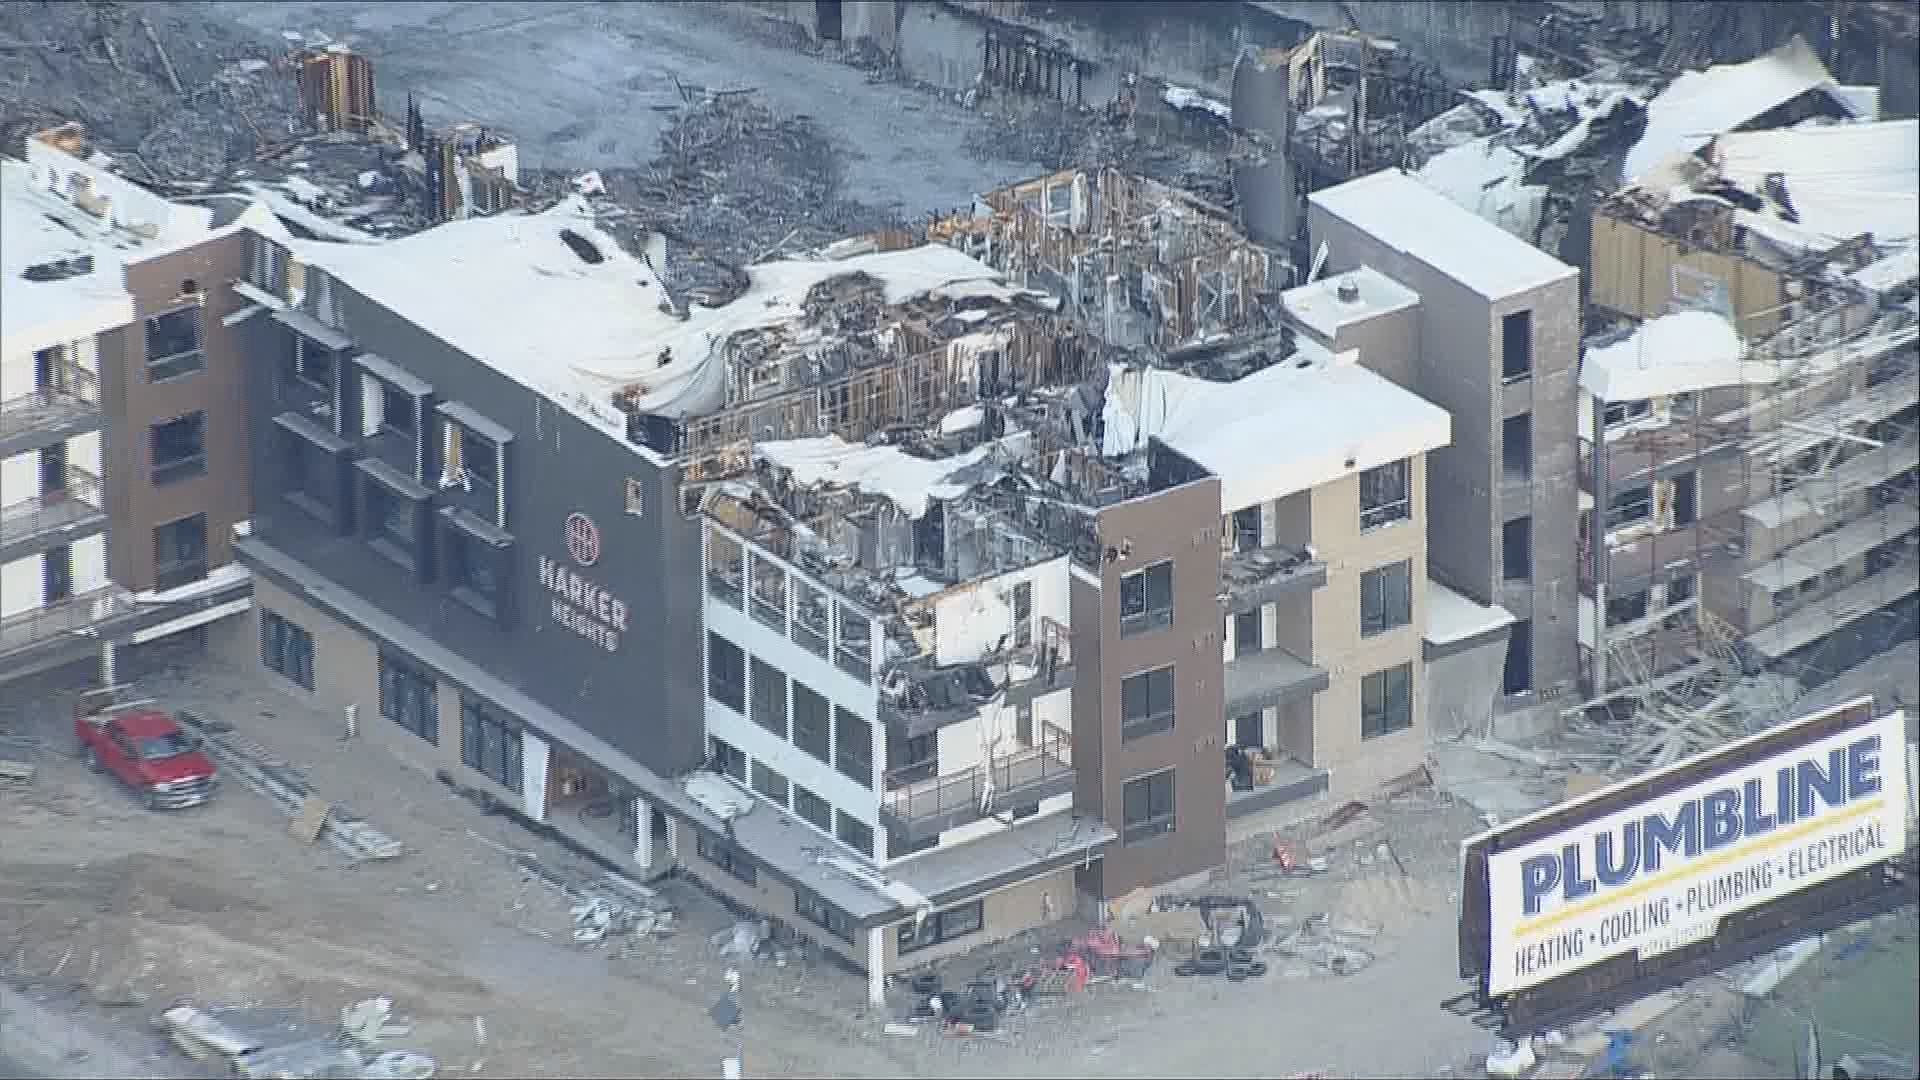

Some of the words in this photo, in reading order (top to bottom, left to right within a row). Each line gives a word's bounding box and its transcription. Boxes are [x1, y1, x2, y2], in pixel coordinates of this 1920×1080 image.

[538, 555, 627, 632] HARKER
[551, 599, 618, 652] HEIGHTS
[1520, 735, 1882, 915] PLUMBLINE
[1515, 930, 1584, 977] HEATING
[1599, 898, 1671, 945] COOLING
[1686, 859, 1774, 917] PLUMBING
[1787, 822, 1887, 880] ELECTRICAL
